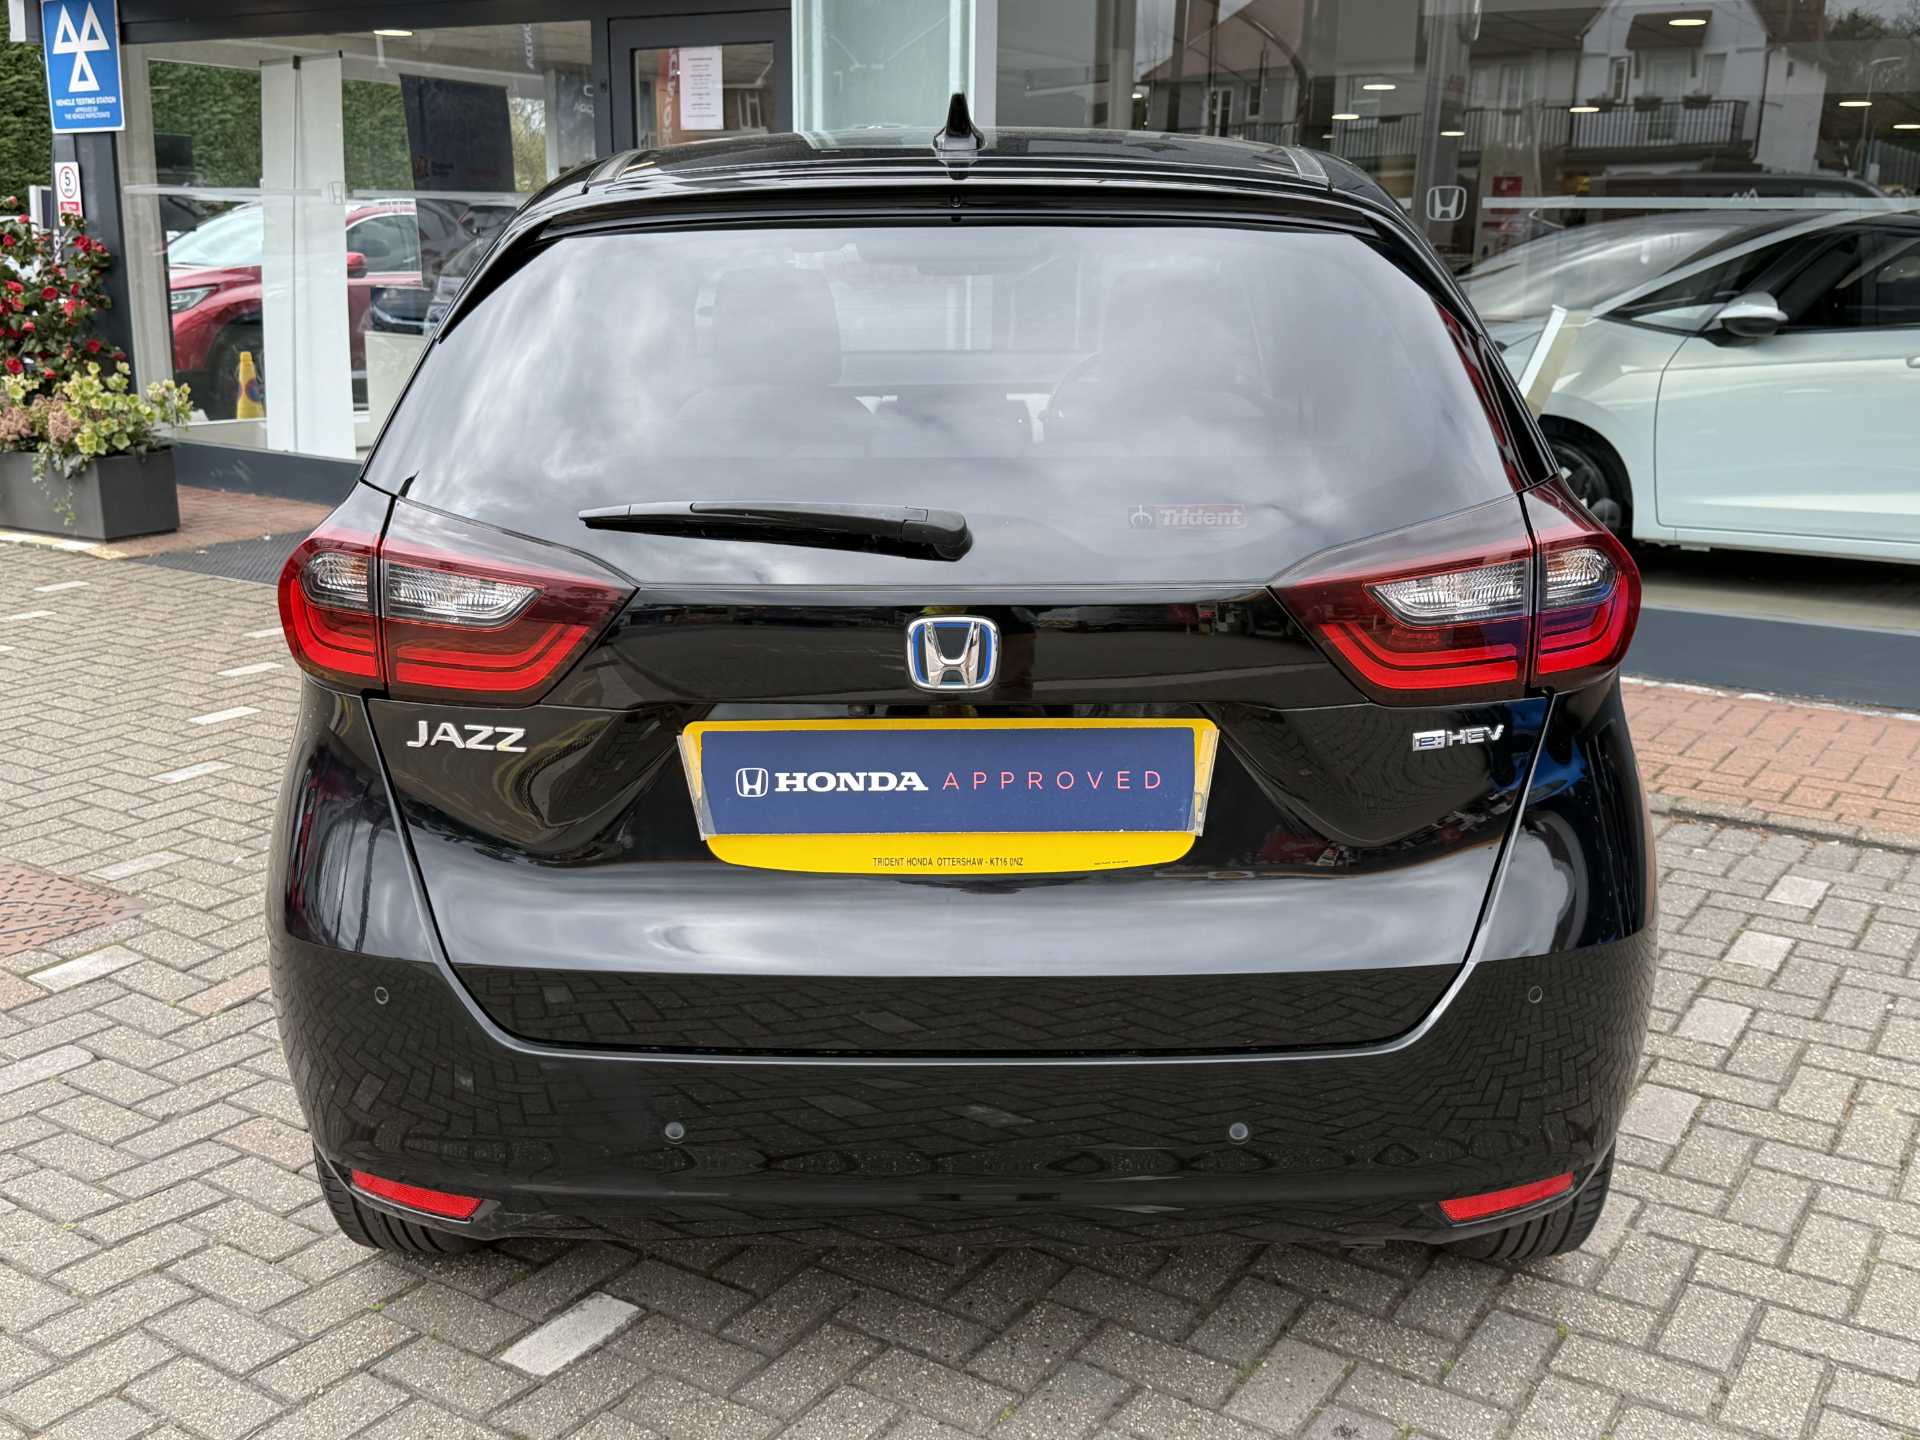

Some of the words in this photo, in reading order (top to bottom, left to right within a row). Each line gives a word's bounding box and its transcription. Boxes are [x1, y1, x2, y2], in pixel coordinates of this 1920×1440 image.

[64, 171, 71, 186] 5
[1160, 508, 1242, 525] Trident
[406, 720, 527, 753] JAZZ
[774, 771, 929, 792] HONDA
[942, 770, 1161, 790] APPROVED
[872, 857, 904, 866] TRIDENT
[907, 857, 933, 866] HONDA
[937, 857, 984, 866] OTTERSHAW
